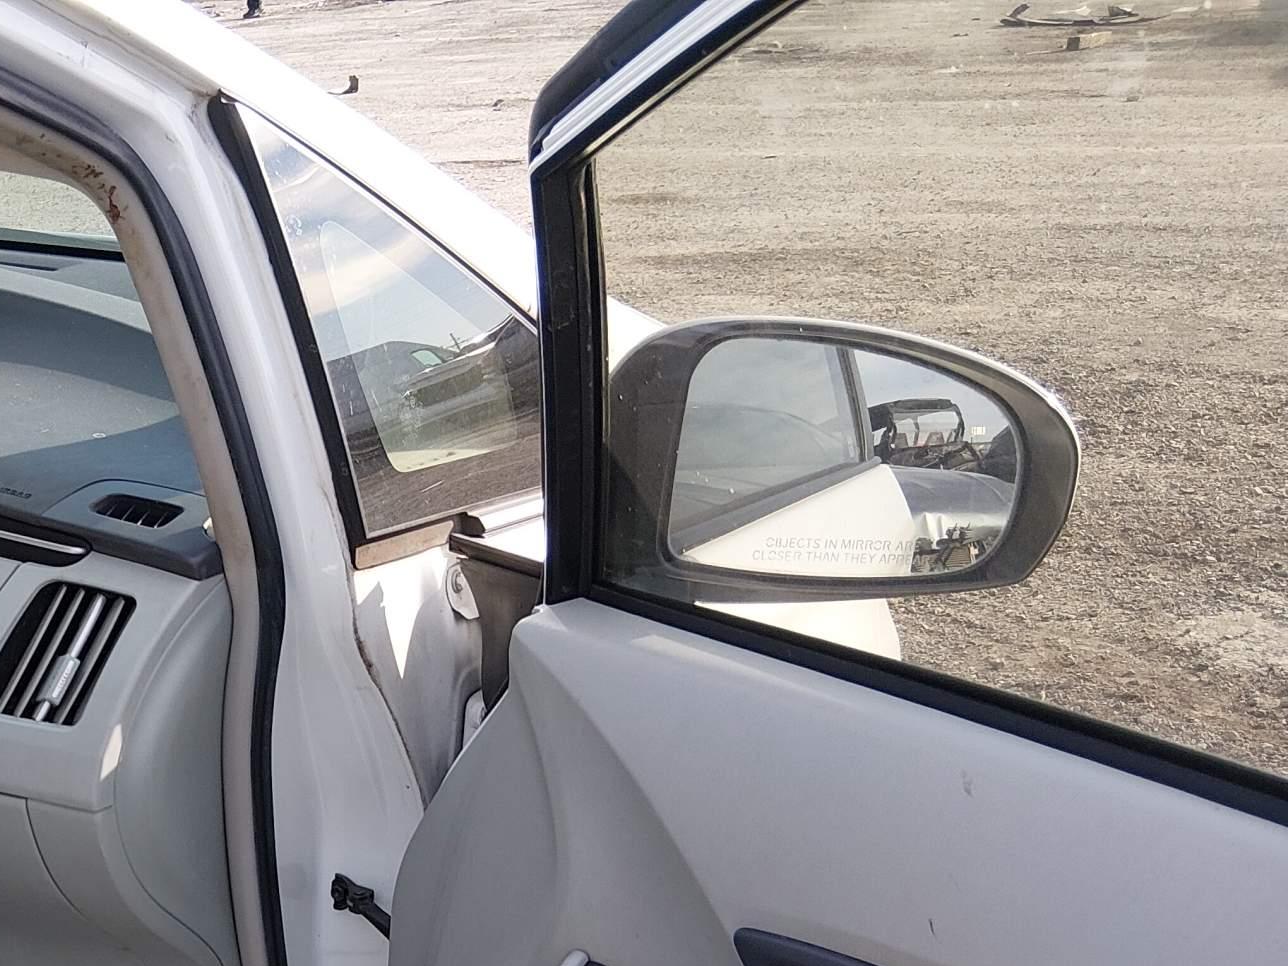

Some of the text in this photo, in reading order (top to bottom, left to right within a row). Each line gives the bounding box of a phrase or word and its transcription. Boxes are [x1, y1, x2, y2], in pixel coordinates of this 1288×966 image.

[765, 536, 821, 550] OBJECTS
[824, 537, 838, 550] IN
[840, 538, 892, 551] MIRROR
[751, 550, 804, 562] CLOSER
[806, 551, 840, 563] THAN
[843, 552, 878, 565] THEY
